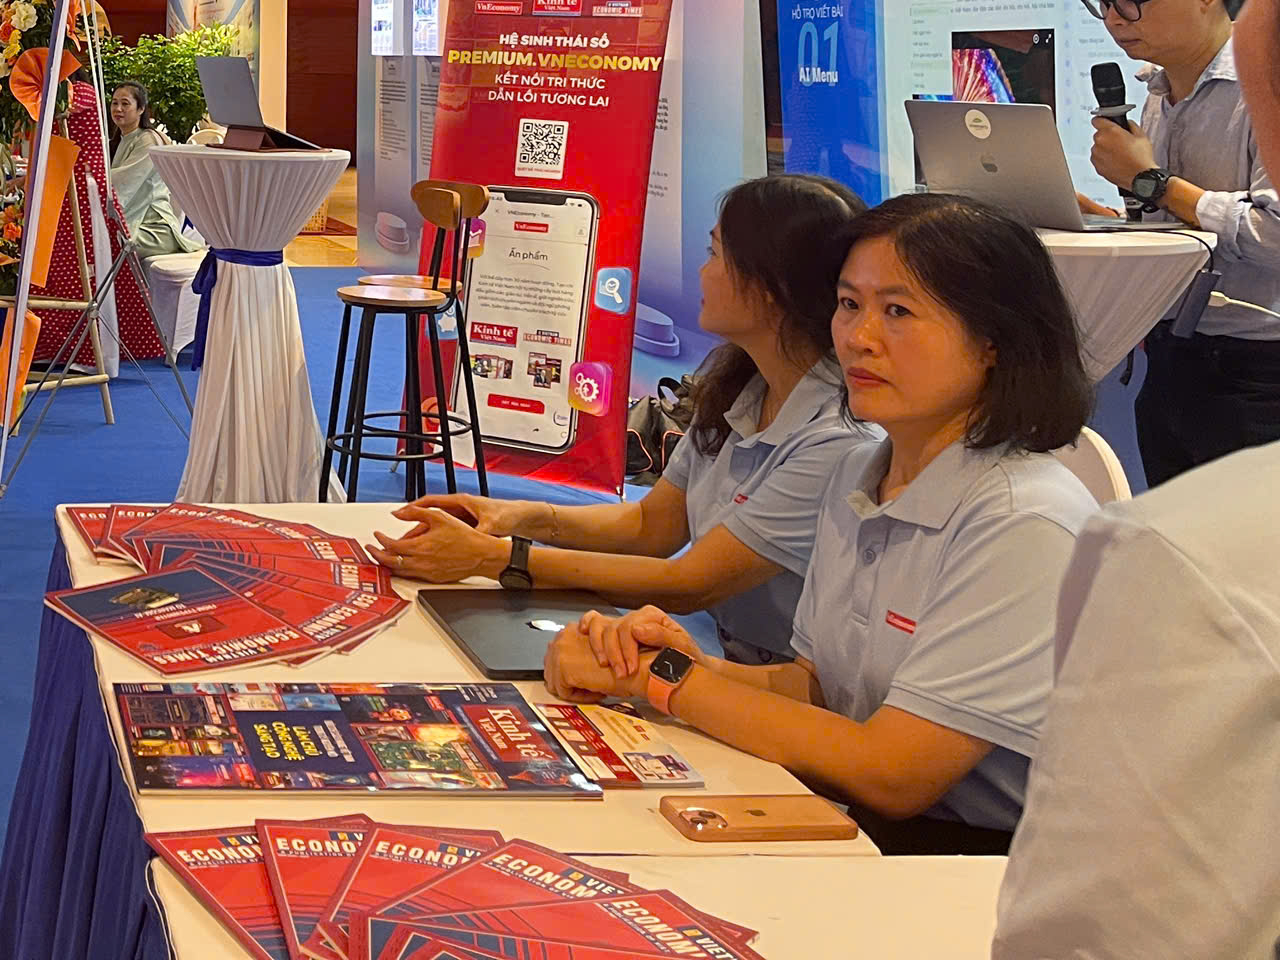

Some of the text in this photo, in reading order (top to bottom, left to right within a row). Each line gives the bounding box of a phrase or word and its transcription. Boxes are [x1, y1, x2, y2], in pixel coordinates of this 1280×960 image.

[477, 3, 521, 14] VnEconomy
[625, 7, 643, 15] TIMES
[499, 32, 610, 49] HỆ SINH THÁI SỐ
[447, 49, 662, 72] PREMIUM.VNECONOMY
[798, 21, 839, 87] 01
[495, 71, 606, 89] KẾT NỐI TRI THỨC
[799, 67, 839, 83] AI Menu
[488, 88, 609, 107] DẪN LỐI TƯƠNG LAI
[474, 324, 516, 338] Kinh tế
[210, 629, 300, 654] ECONOMIC
[153, 648, 208, 665] TIMES
[488, 708, 531, 742] Kinh
[276, 837, 361, 853] ECONO
[612, 899, 707, 958] ECONOM
